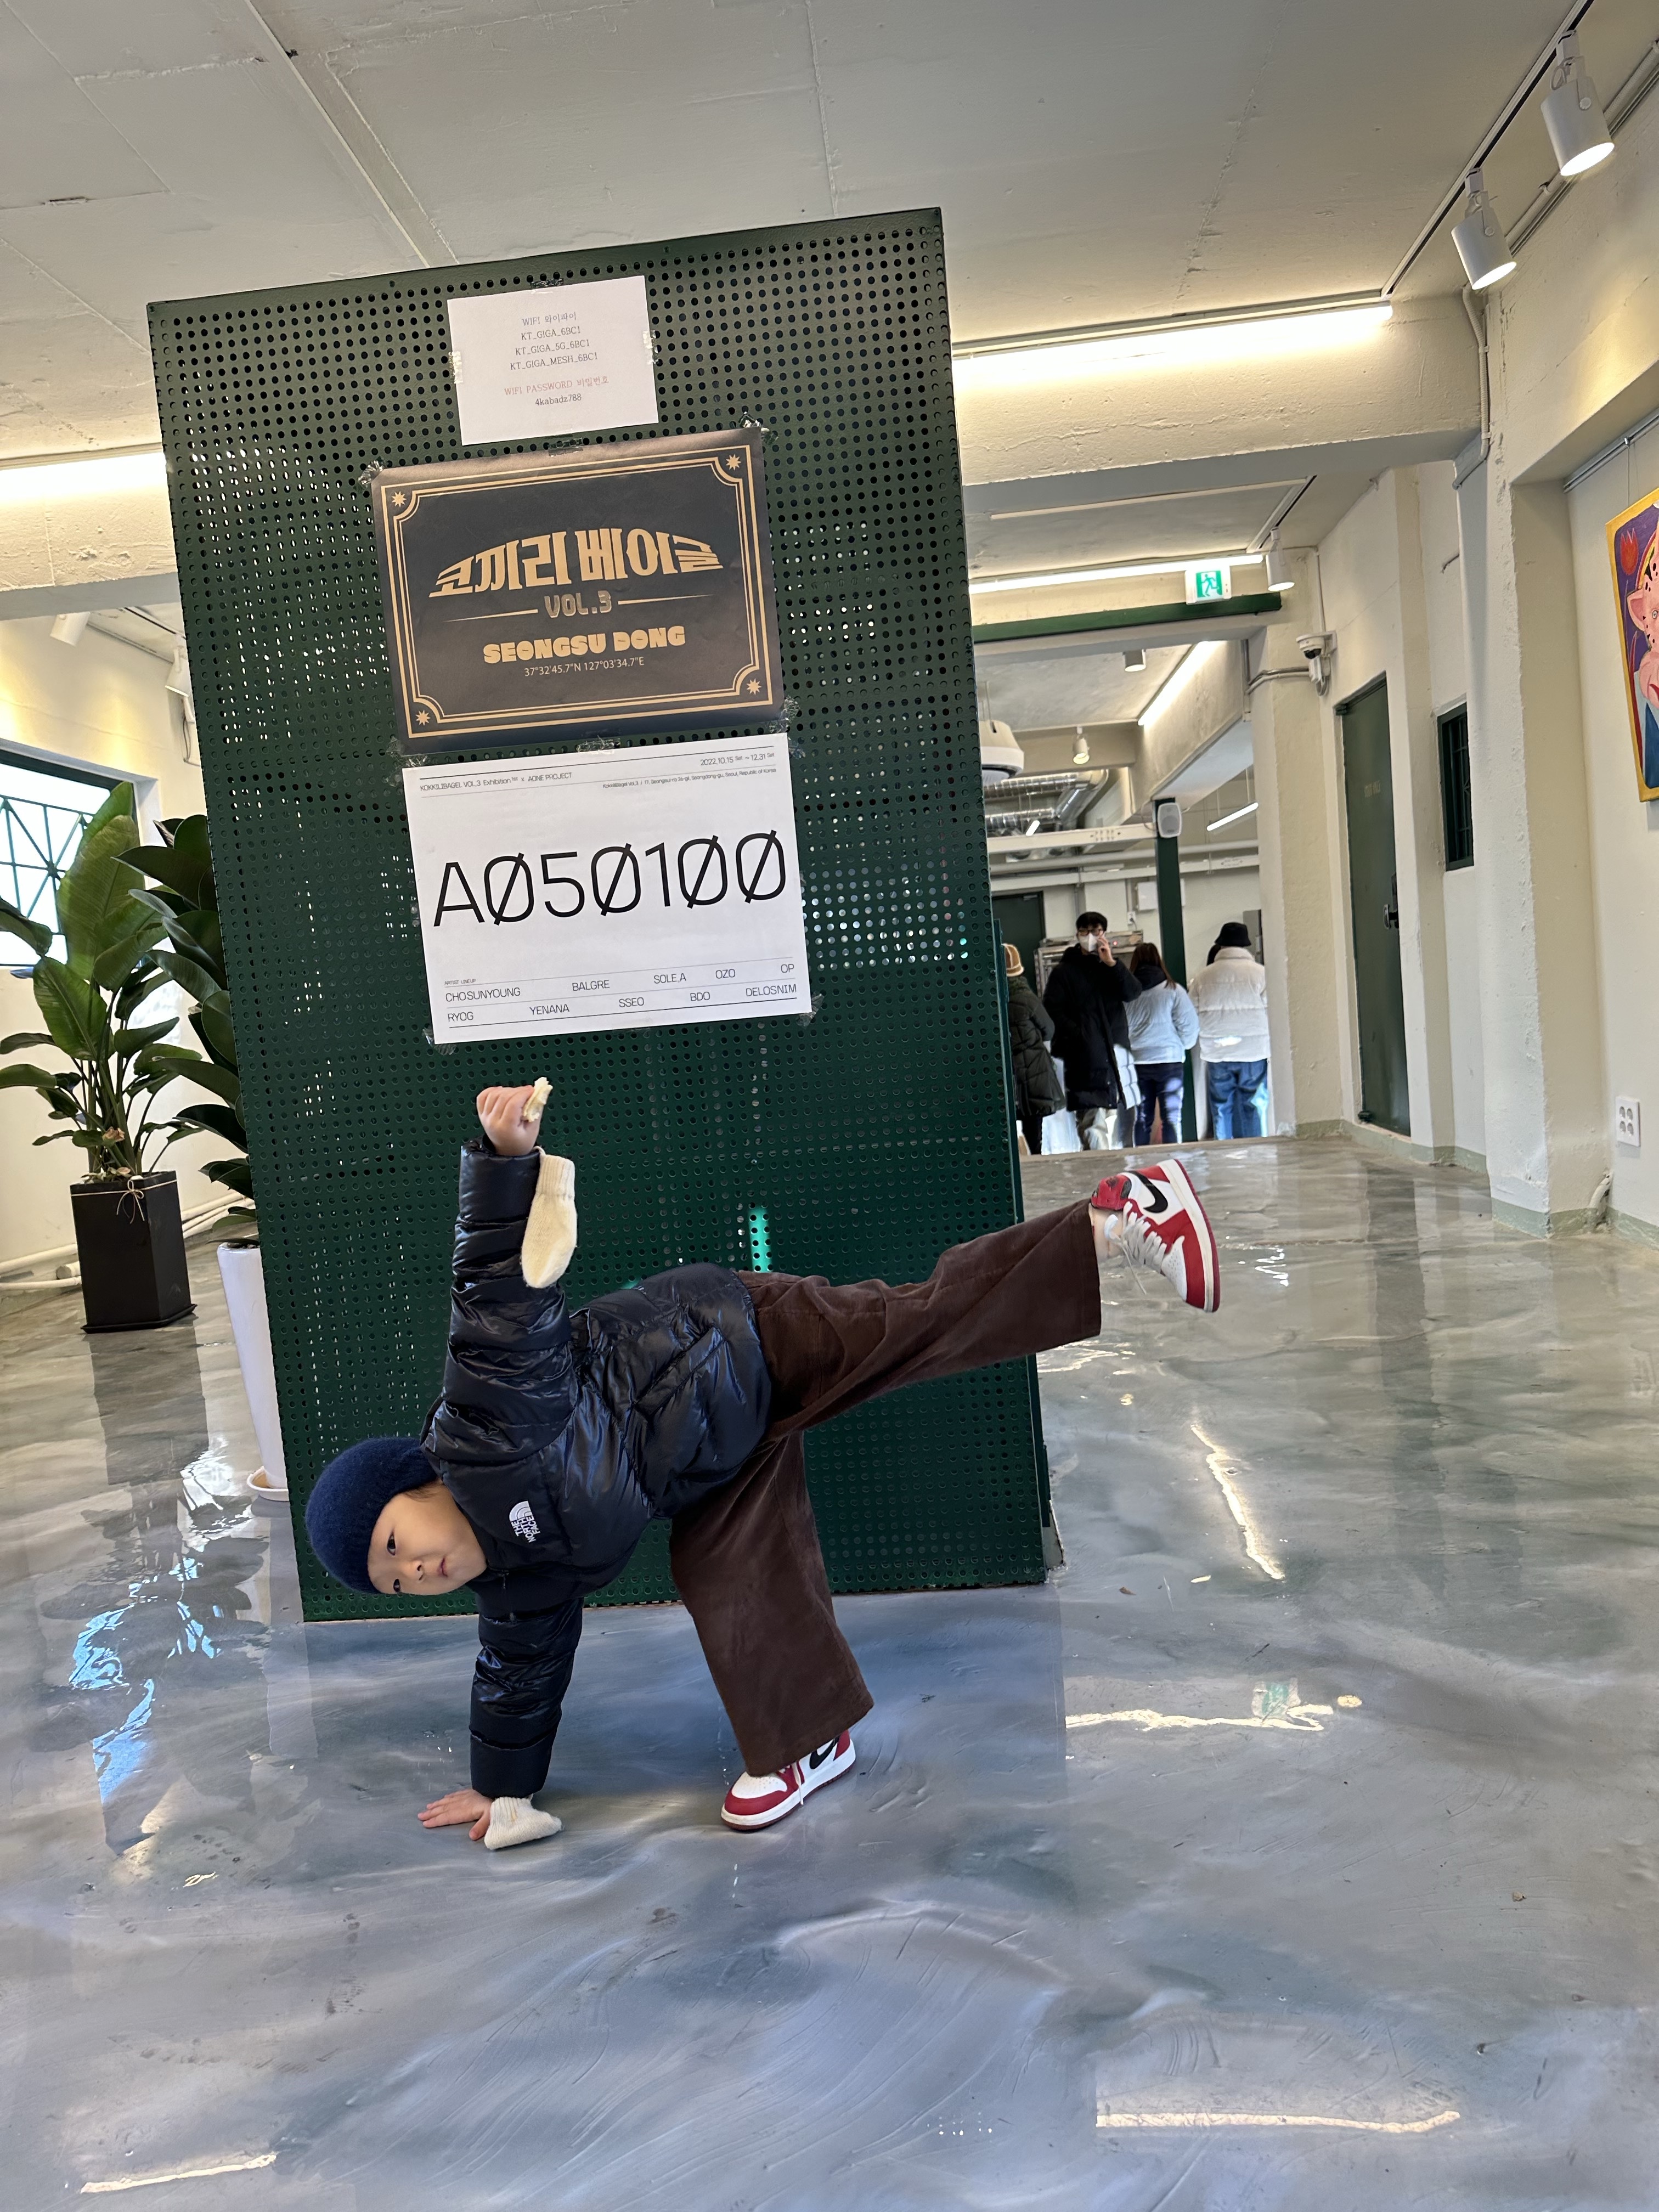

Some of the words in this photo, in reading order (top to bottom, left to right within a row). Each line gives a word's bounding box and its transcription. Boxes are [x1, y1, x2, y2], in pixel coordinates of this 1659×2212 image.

[522, 317, 540, 326] WIFI
[544, 312, 577, 324] 와이파이
[521, 326, 581, 341] KT_GIGA_6BC1
[515, 339, 590, 356] KT_GIGA_5G_6BC1
[510, 352, 597, 370] KT_GIGA_MESH_6BC1
[504, 386, 522, 396] WIFI
[526, 380, 573, 393] PASSWORD
[577, 375, 610, 387] 비밀번호
[535, 393, 582, 406] 4kabadz788
[428, 531, 572, 598] 코끼리
[574, 528, 724, 582] 베이글
[544, 590, 613, 619] VOL.3
[483, 633, 607, 664] SEONGSU
[613, 625, 686, 652] DONG
[700, 756, 734, 766] 2022.10.15
[420, 781, 462, 791] KOKKILIBAGEL
[464, 780, 481, 788] VOL.3
[715, 969, 736, 979] OZO
[781, 964, 794, 973] OP
[572, 980, 610, 991] BALGRE
[746, 984, 797, 997] DELOSNIM
[445, 988, 521, 1002] CHOSUNYOUNG
[690, 992, 710, 1001] BDO
[529, 1004, 570, 1015] YENANA
[619, 997, 645, 1008] SSEO
[448, 1012, 474, 1022] RYOG
[511, 1520, 524, 1537] THE
[518, 1517, 537, 1543] NORTH
[526, 1515, 541, 1535] FACE
